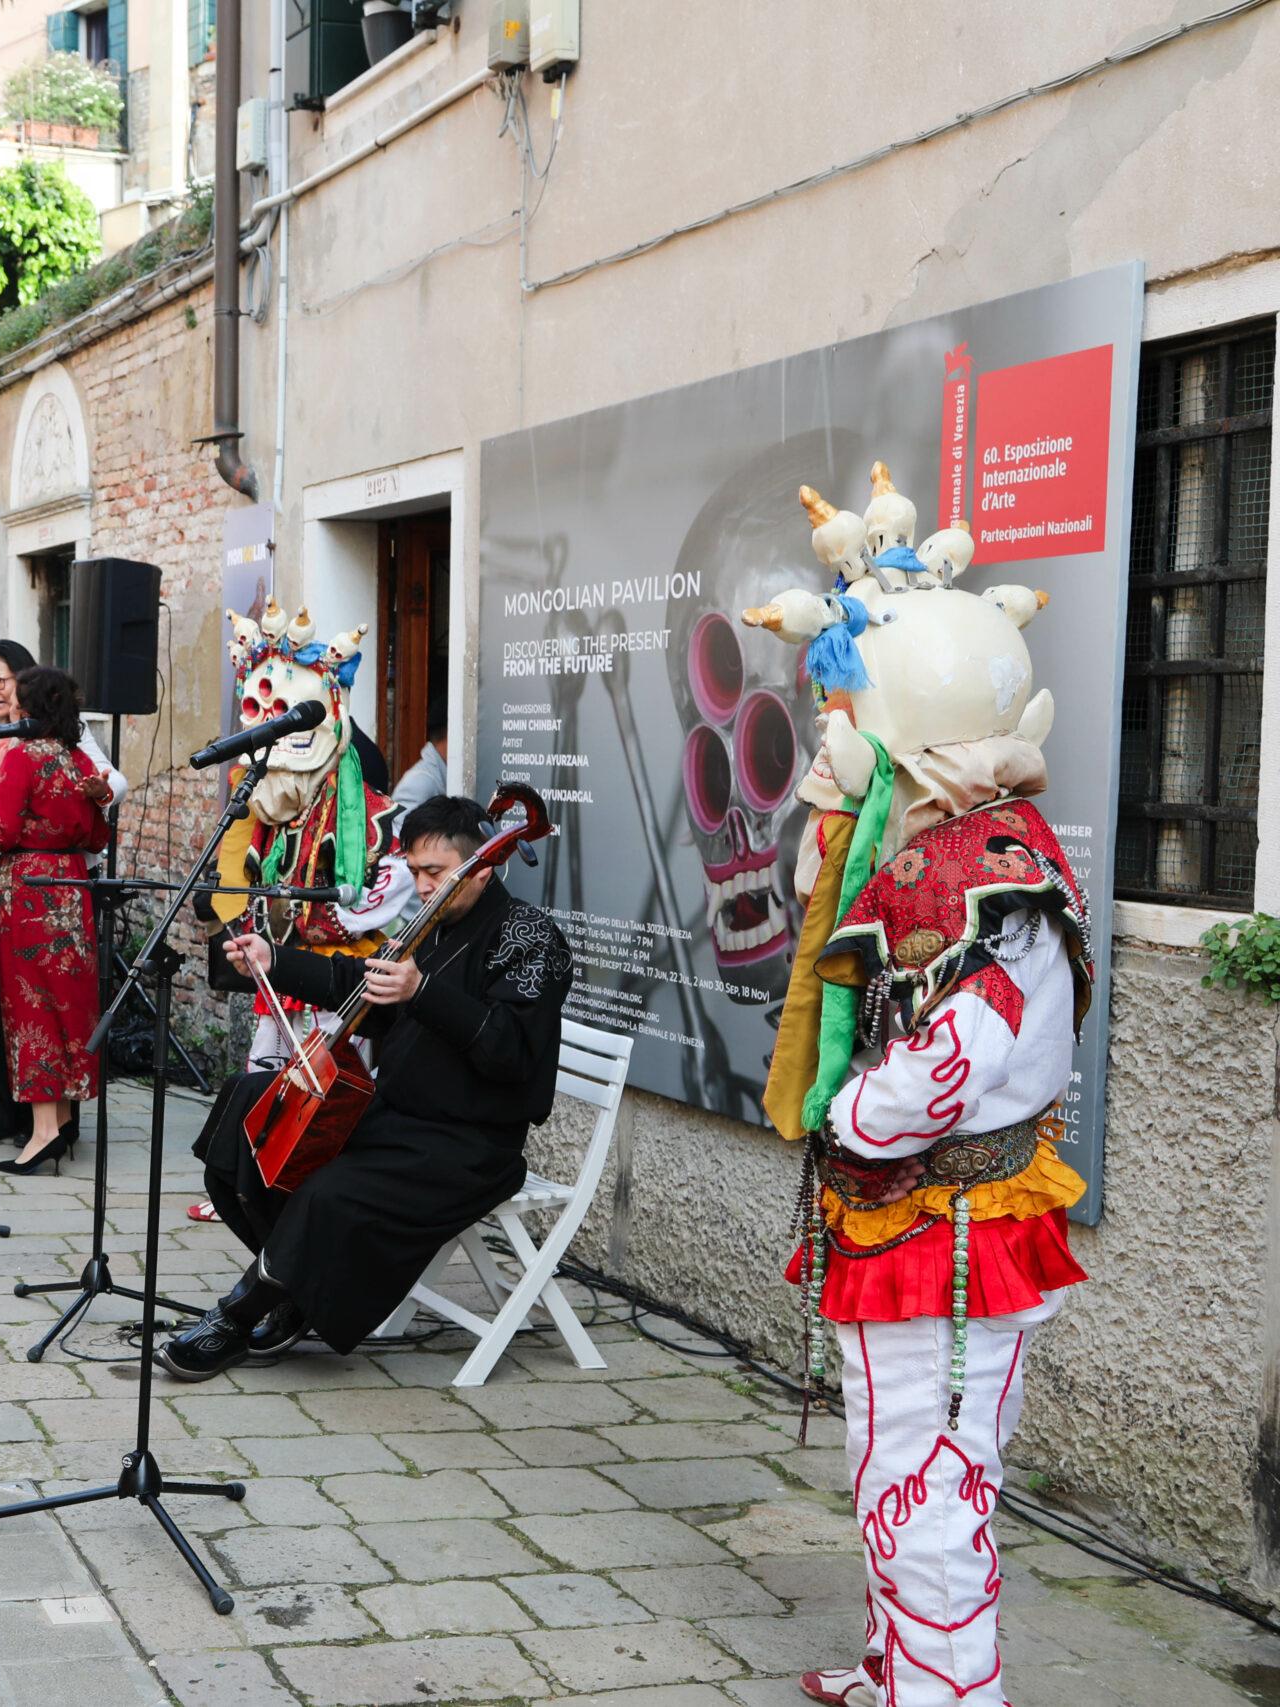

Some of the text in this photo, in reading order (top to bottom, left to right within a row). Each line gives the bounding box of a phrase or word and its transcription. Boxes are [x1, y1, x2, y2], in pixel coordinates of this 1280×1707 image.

[953, 384, 965, 441] Venezia
[952, 445, 963, 460] di
[983, 435, 1073, 465] 60. Esposizione
[982, 457, 1067, 489] Internazionale
[981, 491, 1016, 512] d'Arte
[981, 515, 1093, 544] Partecipazioni Nazionali
[504, 570, 701, 617] MONGOLIAN PAVILION
[503, 629, 671, 660] DISCOVERING THE PRESENT
[503, 653, 613, 677] FROM THE FUTURE
[502, 719, 562, 731] NOMIN CHINBAT
[501, 753, 590, 767] OCHIRBOLD AYURZANA
[541, 788, 594, 803] OYUNJARGAL
[566, 923, 574, 934] 30
[615, 931, 620, 942] 11
[620, 932, 632, 945] AM
[637, 935, 642, 946] 7
[642, 937, 654, 948] PM
[610, 945, 618, 956] 10
[618, 946, 629, 958] AM
[633, 949, 638, 960] 6
[639, 950, 650, 962] PM
[623, 961, 631, 973] 22
[646, 966, 654, 977] 17
[669, 971, 678, 983] 22
[693, 976, 698, 987] 2
[714, 980, 724, 992] 30
[741, 985, 750, 998] 18
